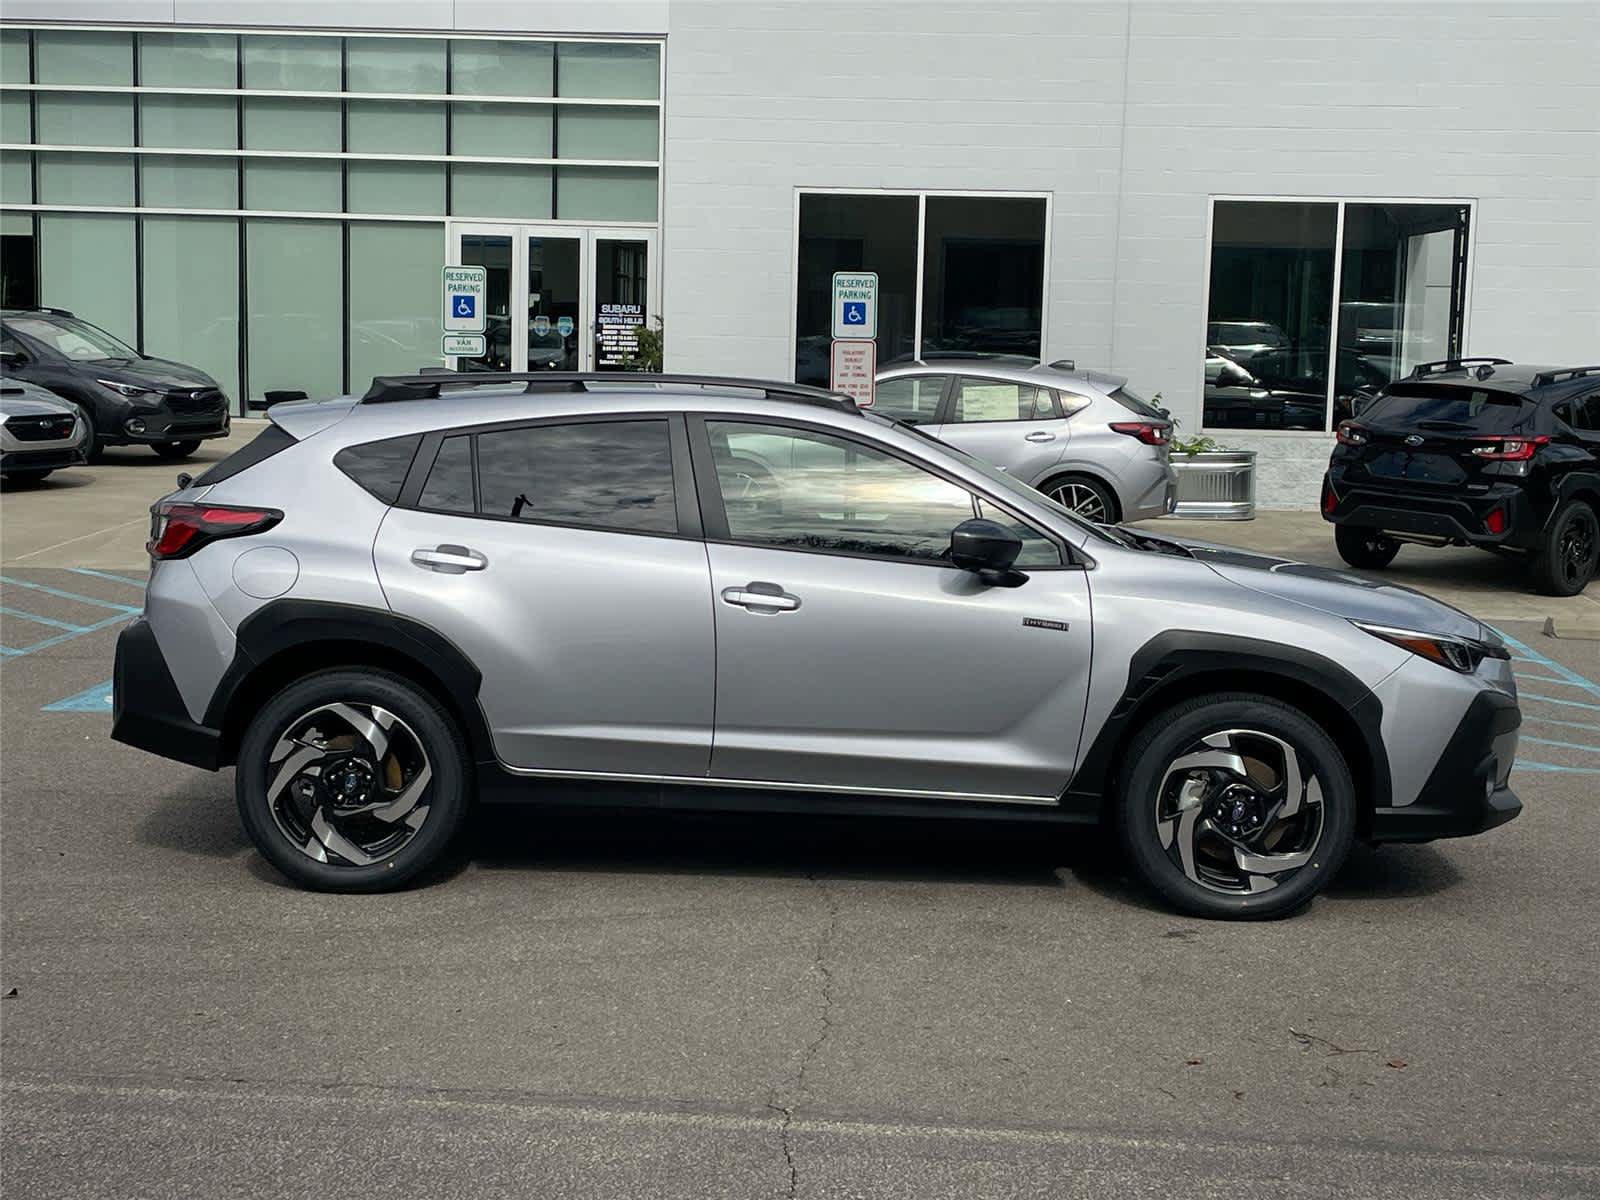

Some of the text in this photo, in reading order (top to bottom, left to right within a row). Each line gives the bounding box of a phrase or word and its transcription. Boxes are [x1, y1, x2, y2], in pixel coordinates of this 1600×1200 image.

[446, 271, 483, 281] RESERVED
[448, 283, 480, 293] PARKING
[836, 279, 875, 289] RESERVED
[838, 290, 872, 300] PARKING
[601, 304, 641, 314] SUBARU
